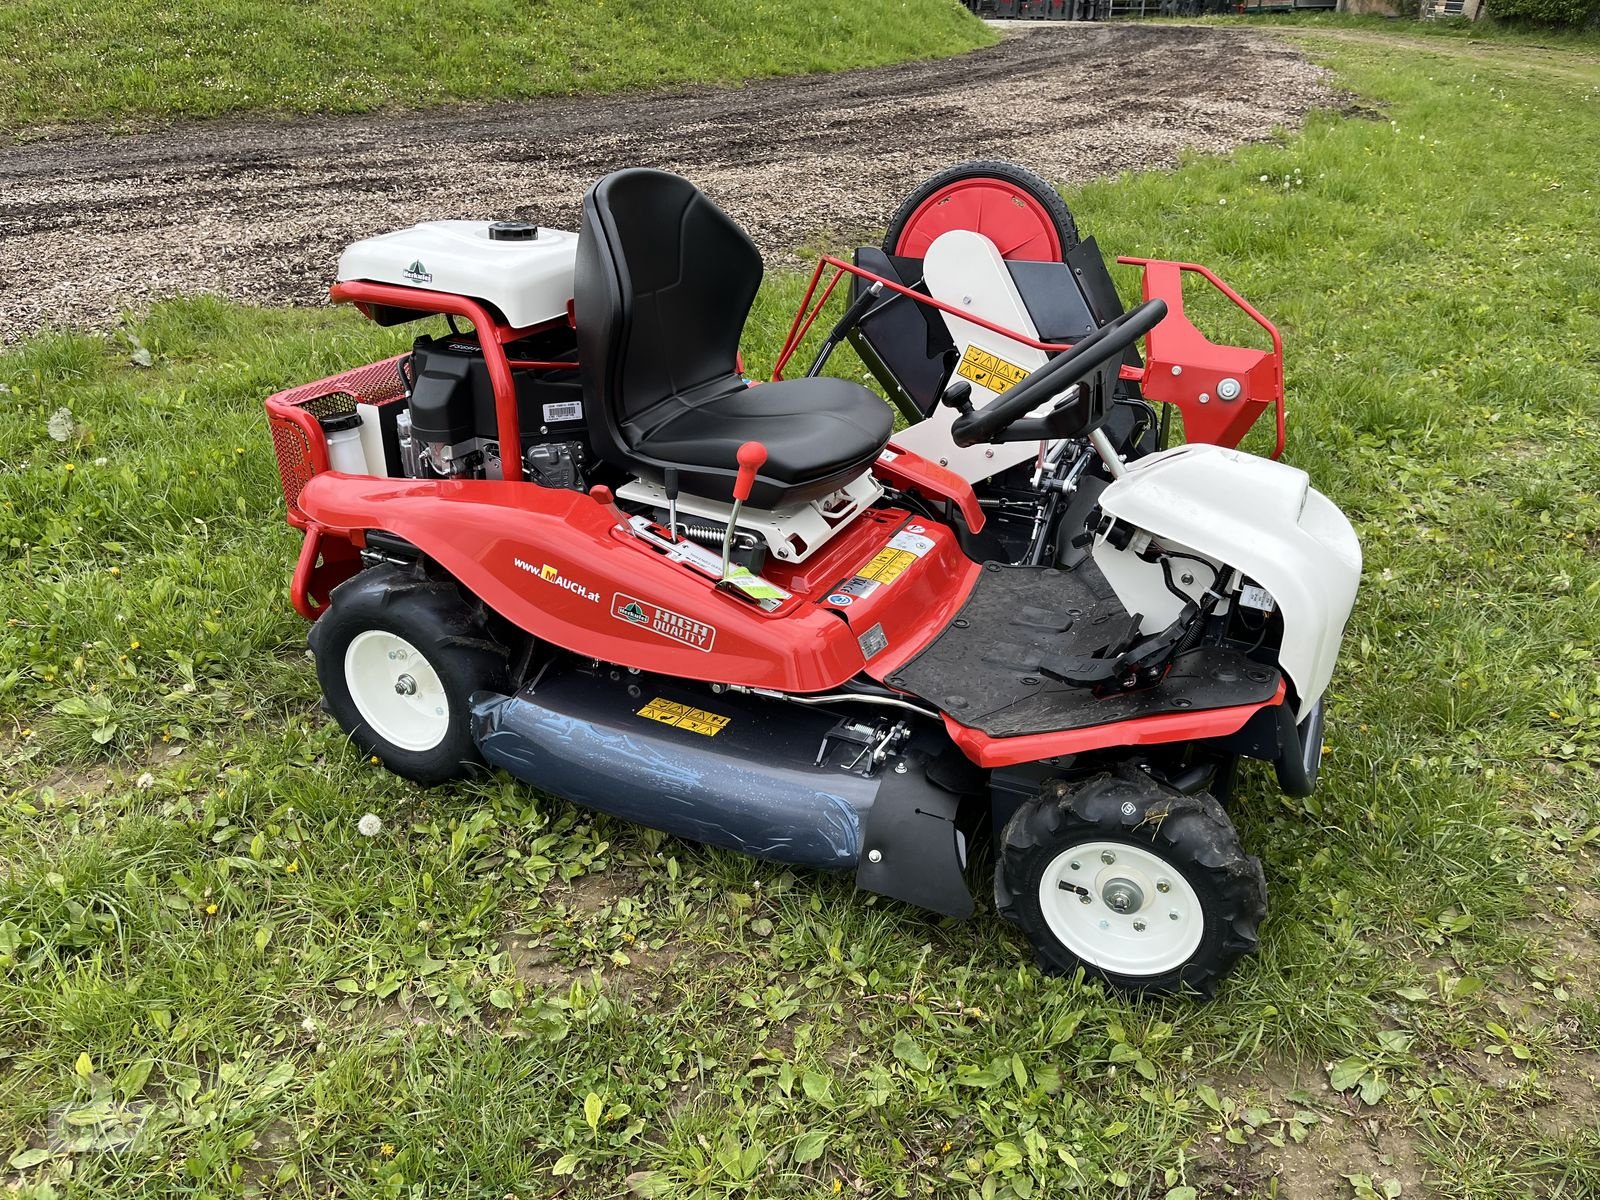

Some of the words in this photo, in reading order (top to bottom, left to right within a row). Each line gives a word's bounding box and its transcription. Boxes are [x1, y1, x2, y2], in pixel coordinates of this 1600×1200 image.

[514, 557, 600, 603] www.MAUCH.at
[653, 619, 706, 646] QUALITY
[655, 609, 707, 636] HIGH
